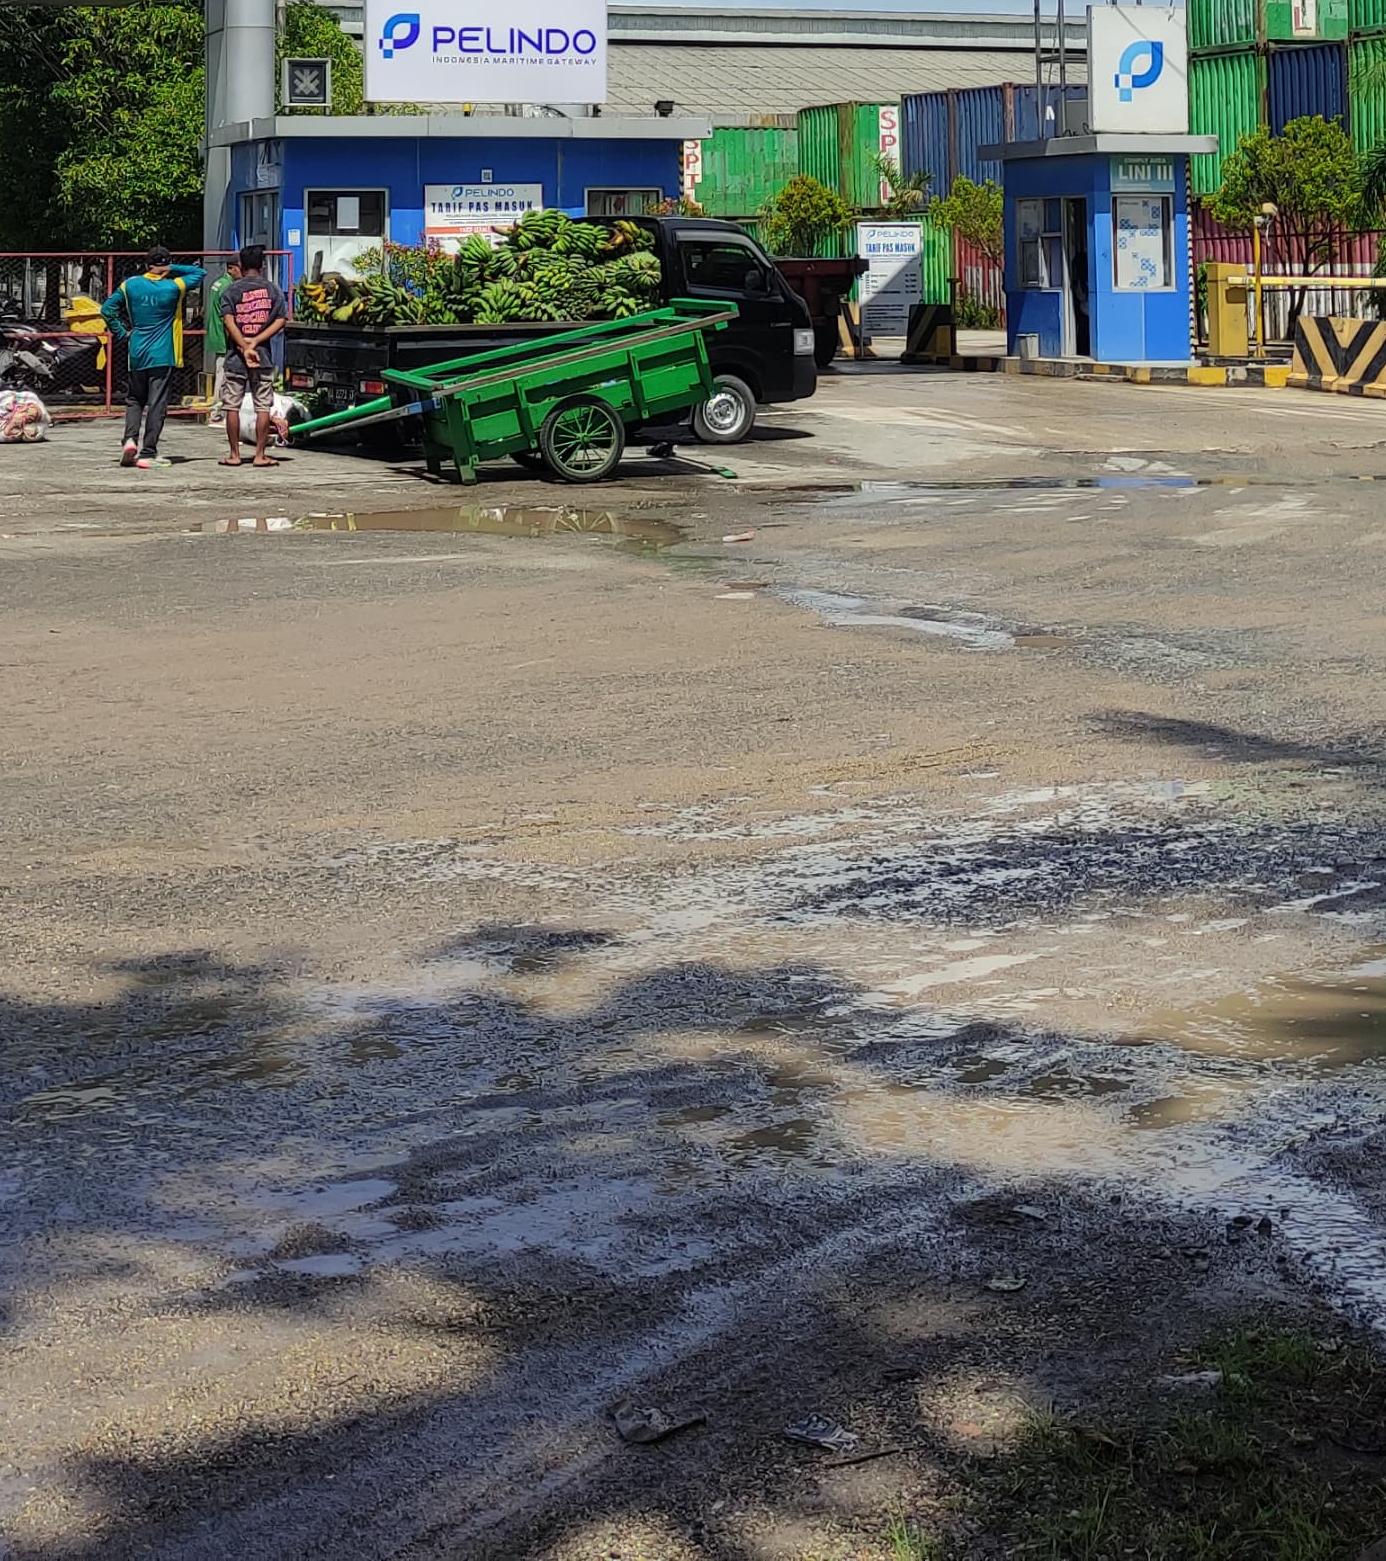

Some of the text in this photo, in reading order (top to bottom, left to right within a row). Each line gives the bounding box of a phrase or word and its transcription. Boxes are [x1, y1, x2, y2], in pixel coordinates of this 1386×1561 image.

[432, 26, 597, 55] PELINDO
[432, 56, 597, 66] INDONESIA MARITIME GATEWAY
[1118, 165, 1174, 181] LINI III
[465, 187, 515, 198] PELINDO
[431, 200, 534, 214] TARIF PAS MASUK
